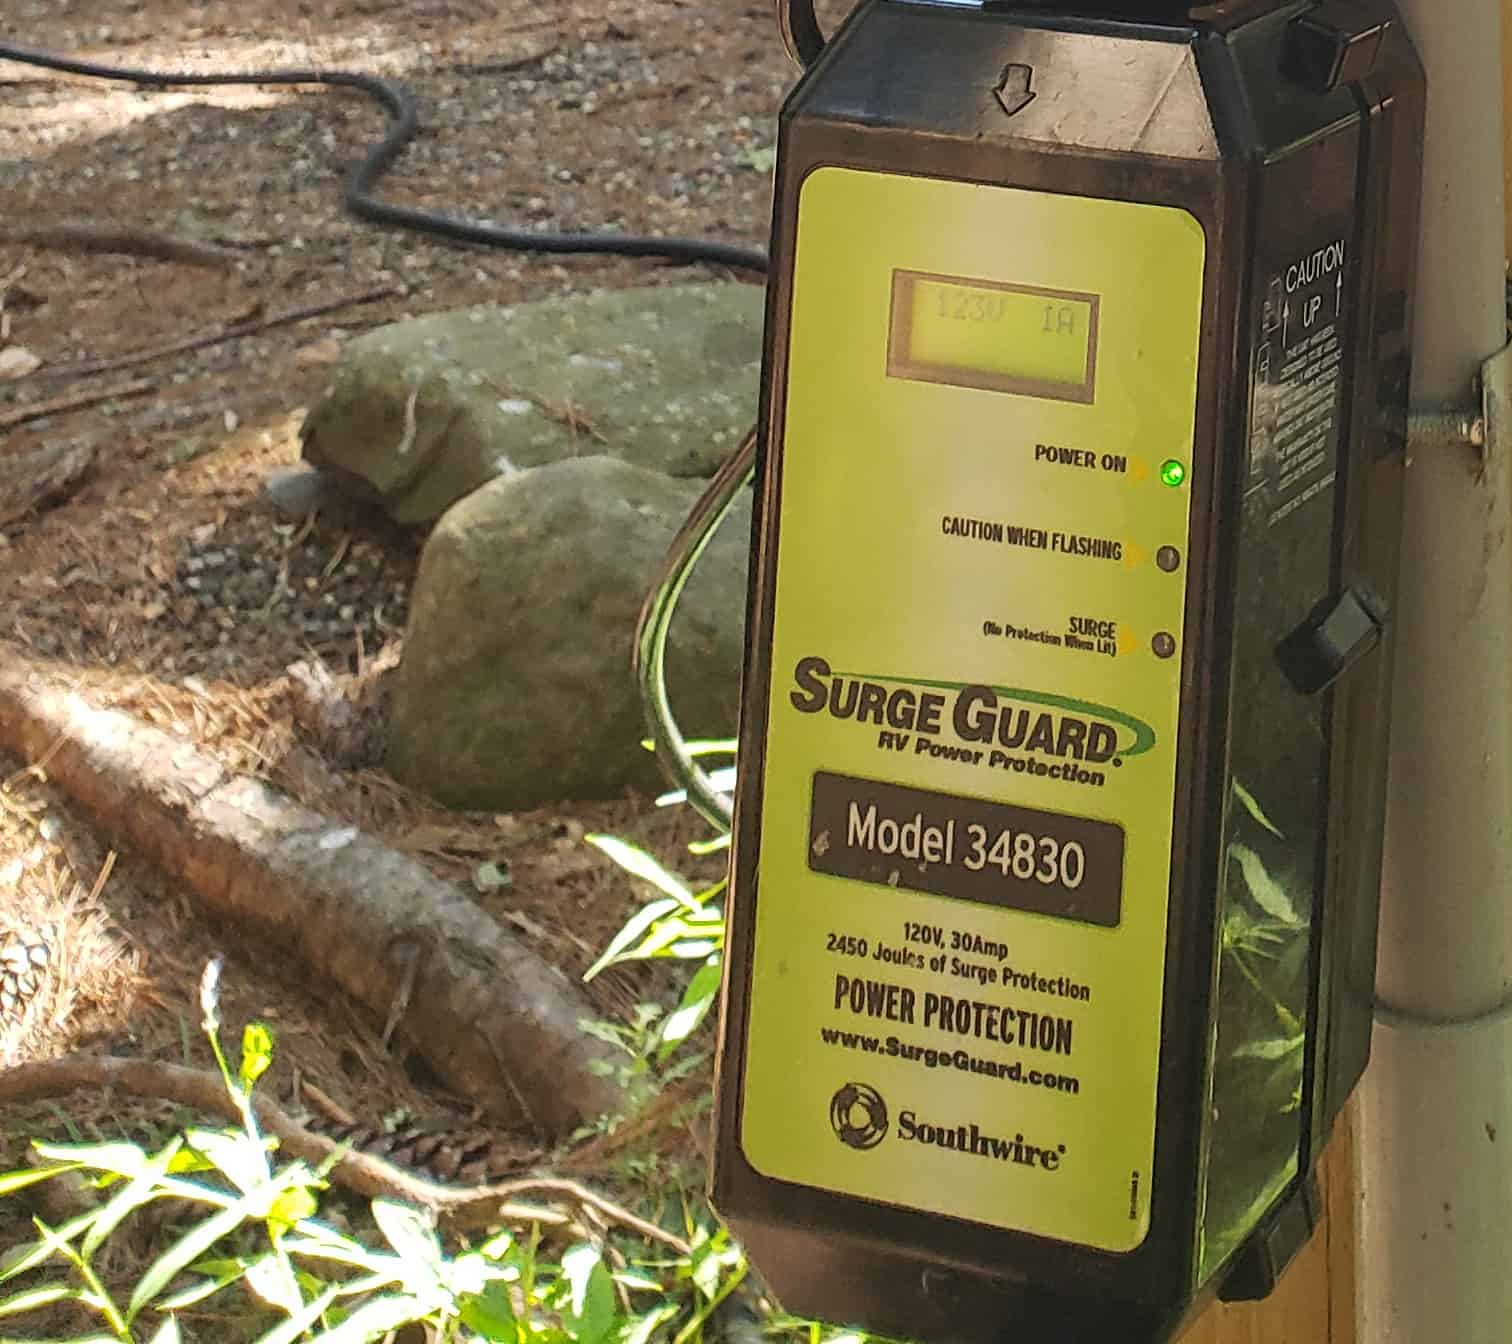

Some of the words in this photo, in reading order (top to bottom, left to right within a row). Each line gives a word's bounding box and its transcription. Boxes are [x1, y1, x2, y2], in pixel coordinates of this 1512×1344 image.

[1286, 240, 1344, 293] CAUTION
[1304, 296, 1321, 328] UP
[1035, 444, 1096, 468] POWER
[1101, 454, 1127, 473] ON
[942, 516, 1003, 543] CAUTION
[1007, 526, 1047, 550] WHEN
[1052, 533, 1122, 561] FLASHING
[1005, 625, 1061, 647] Protection
[1064, 634, 1094, 652] When
[1097, 640, 1117, 657] Lit)
[1069, 616, 1117, 639] SURGE
[790, 656, 945, 734] SURGE
[878, 730, 907, 751] RV
[914, 737, 983, 767] Power
[988, 750, 1104, 786] Protection
[848, 801, 954, 864] Model
[964, 824, 1085, 888] 34830
[827, 933, 867, 957] 2450
[872, 942, 925, 968] Joules
[930, 955, 946, 972] of
[951, 958, 997, 985] Surge
[1002, 967, 1090, 1001] Protection
[904, 922, 945, 949] 120V,
[951, 931, 1008, 961] 30Amp
[834, 974, 915, 1024] POWER
[923, 992, 1072, 1055] PROTECTION
[821, 1027, 1079, 1094] www.SurgeGuard.com
